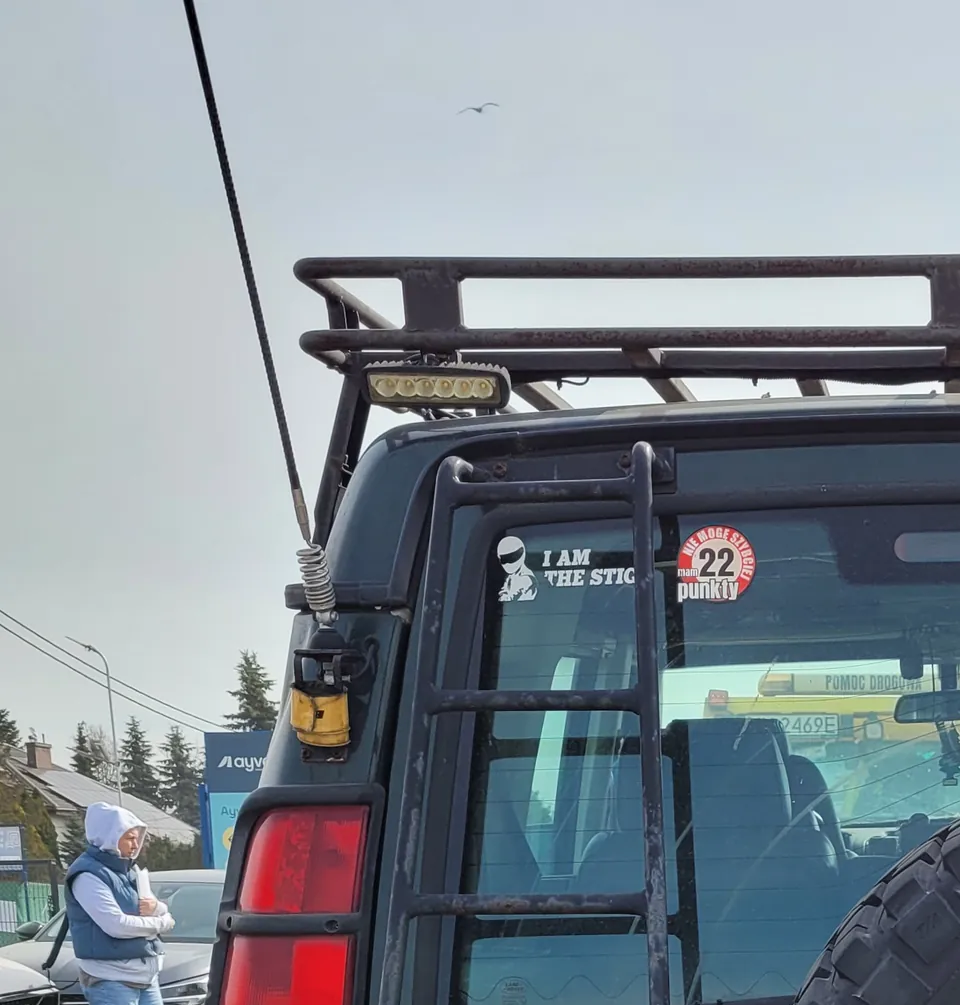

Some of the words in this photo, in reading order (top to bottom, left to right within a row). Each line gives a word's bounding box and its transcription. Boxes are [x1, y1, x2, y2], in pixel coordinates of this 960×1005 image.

[542, 550, 552, 567] I
[556, 549, 592, 566] AM
[682, 537, 699, 557] NIE
[697, 527, 730, 542] MOGĘ
[730, 532, 755, 581] SZYBCIEJ
[699, 547, 735, 577] 22
[544, 569, 586, 587] THE
[589, 567, 636, 586] STIG
[677, 568, 698, 577] mam
[677, 578, 739, 603] punkty
[825, 675, 866, 690] POMOC
